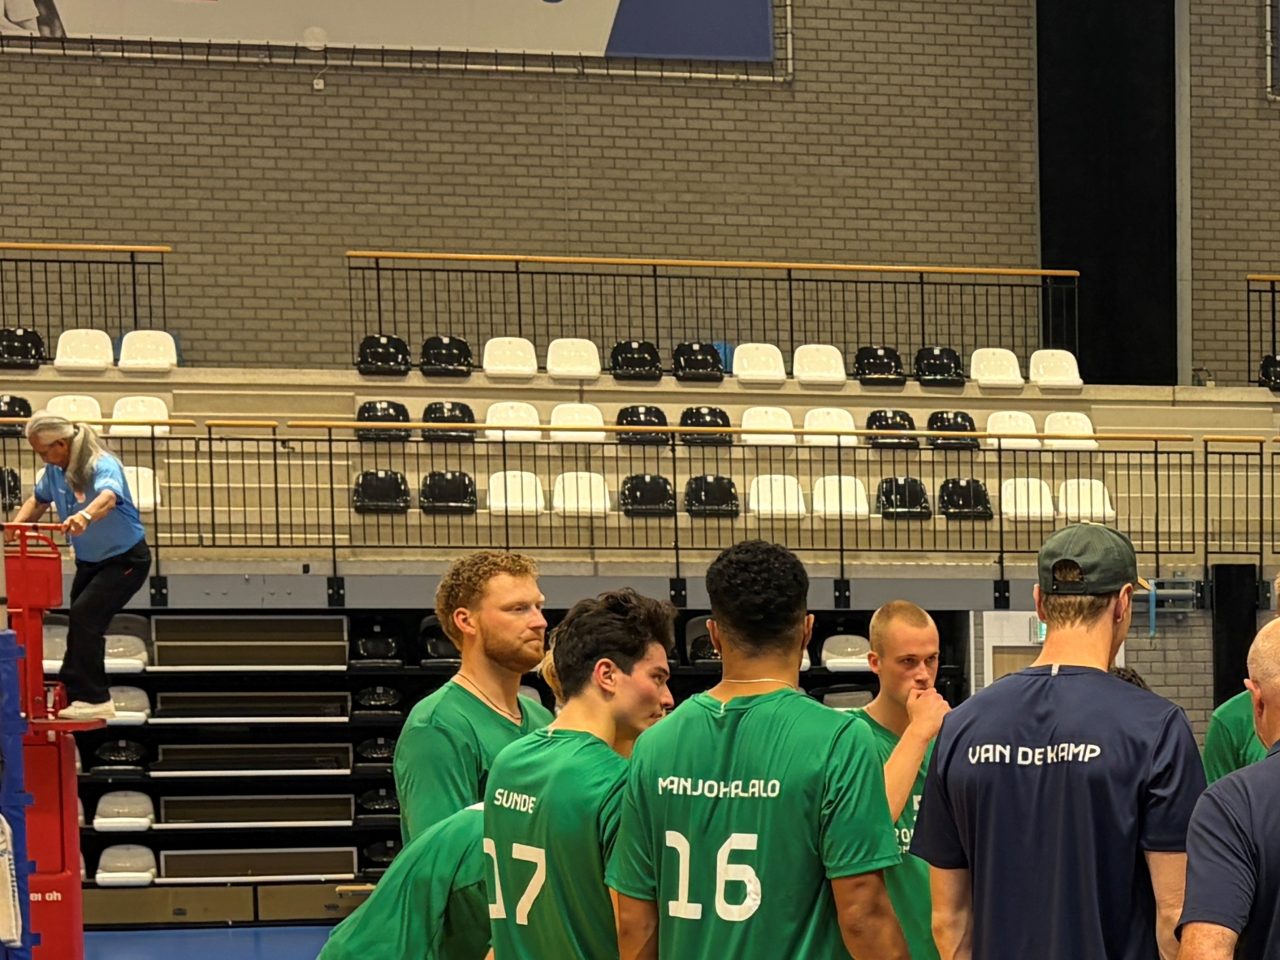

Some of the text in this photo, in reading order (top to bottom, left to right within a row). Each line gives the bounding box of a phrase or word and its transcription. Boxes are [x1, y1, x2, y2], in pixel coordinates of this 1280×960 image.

[968, 743, 1101, 765] VAN DE KAMP
[494, 788, 536, 814] SUNDE
[483, 837, 546, 925] 17
[665, 830, 762, 922] 16
